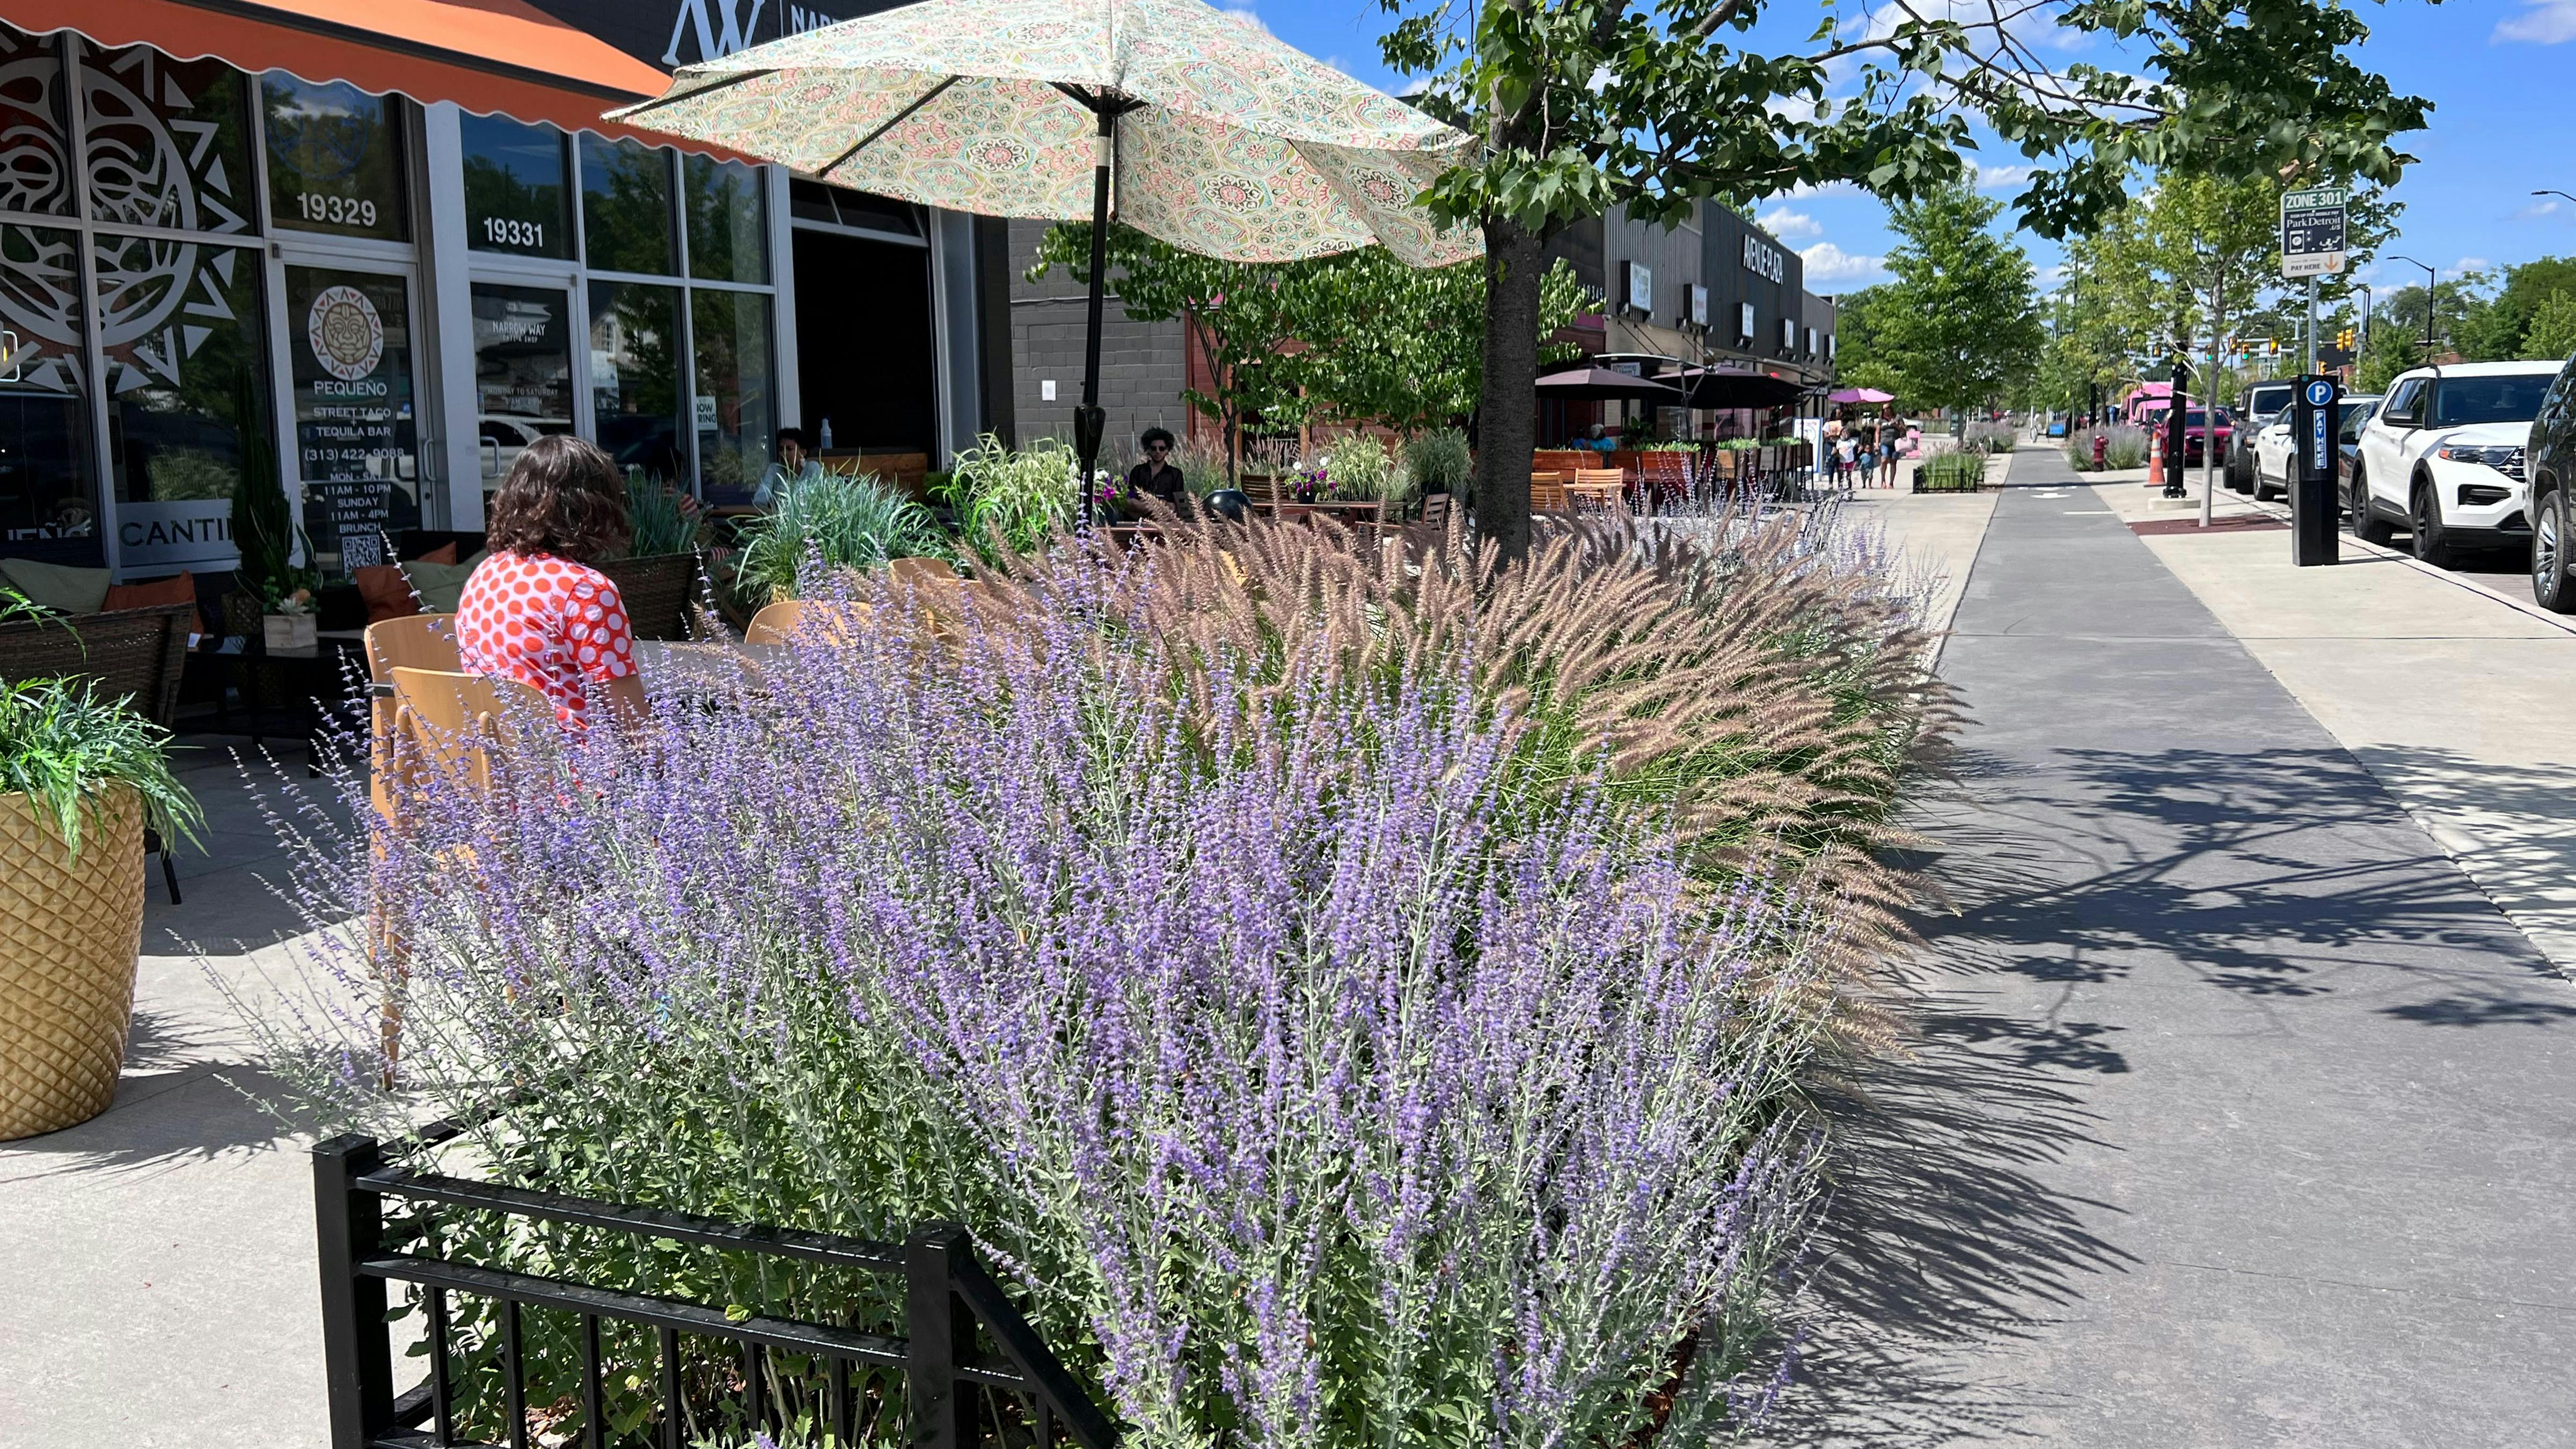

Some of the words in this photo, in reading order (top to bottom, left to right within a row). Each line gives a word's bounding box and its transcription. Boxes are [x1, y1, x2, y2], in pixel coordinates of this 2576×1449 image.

[2286, 193, 2317, 208] ZONE
[2318, 192, 2342, 205] 301
[297, 192, 376, 227] 19329
[484, 216, 543, 248] 19331
[1743, 234, 1767, 277] AVENUE
[1767, 247, 1783, 285] PLAZA
[492, 320, 526, 334] NARROW
[528, 323, 545, 336] WAY
[314, 379, 387, 397] PEQUEÑO
[488, 387, 515, 396] MONDAY
[526, 387, 558, 396] SATURDAY
[2315, 385, 2326, 402] P
[313, 407, 356, 418] STREET
[360, 407, 391, 418] TACO
[316, 426, 365, 439] TEQUILA
[368, 426, 391, 437] BAR
[305, 448, 338, 462] (313)
[2316, 437, 2324, 466] HERE
[330, 473, 353, 481] MON
[363, 473, 382, 481] SAT
[325, 486, 352, 495] 11AM
[337, 497, 378, 508] SUNDAY
[331, 511, 358, 521] 11AM
[368, 509, 389, 519] 4PM
[339, 523, 380, 534] BRUNCH
